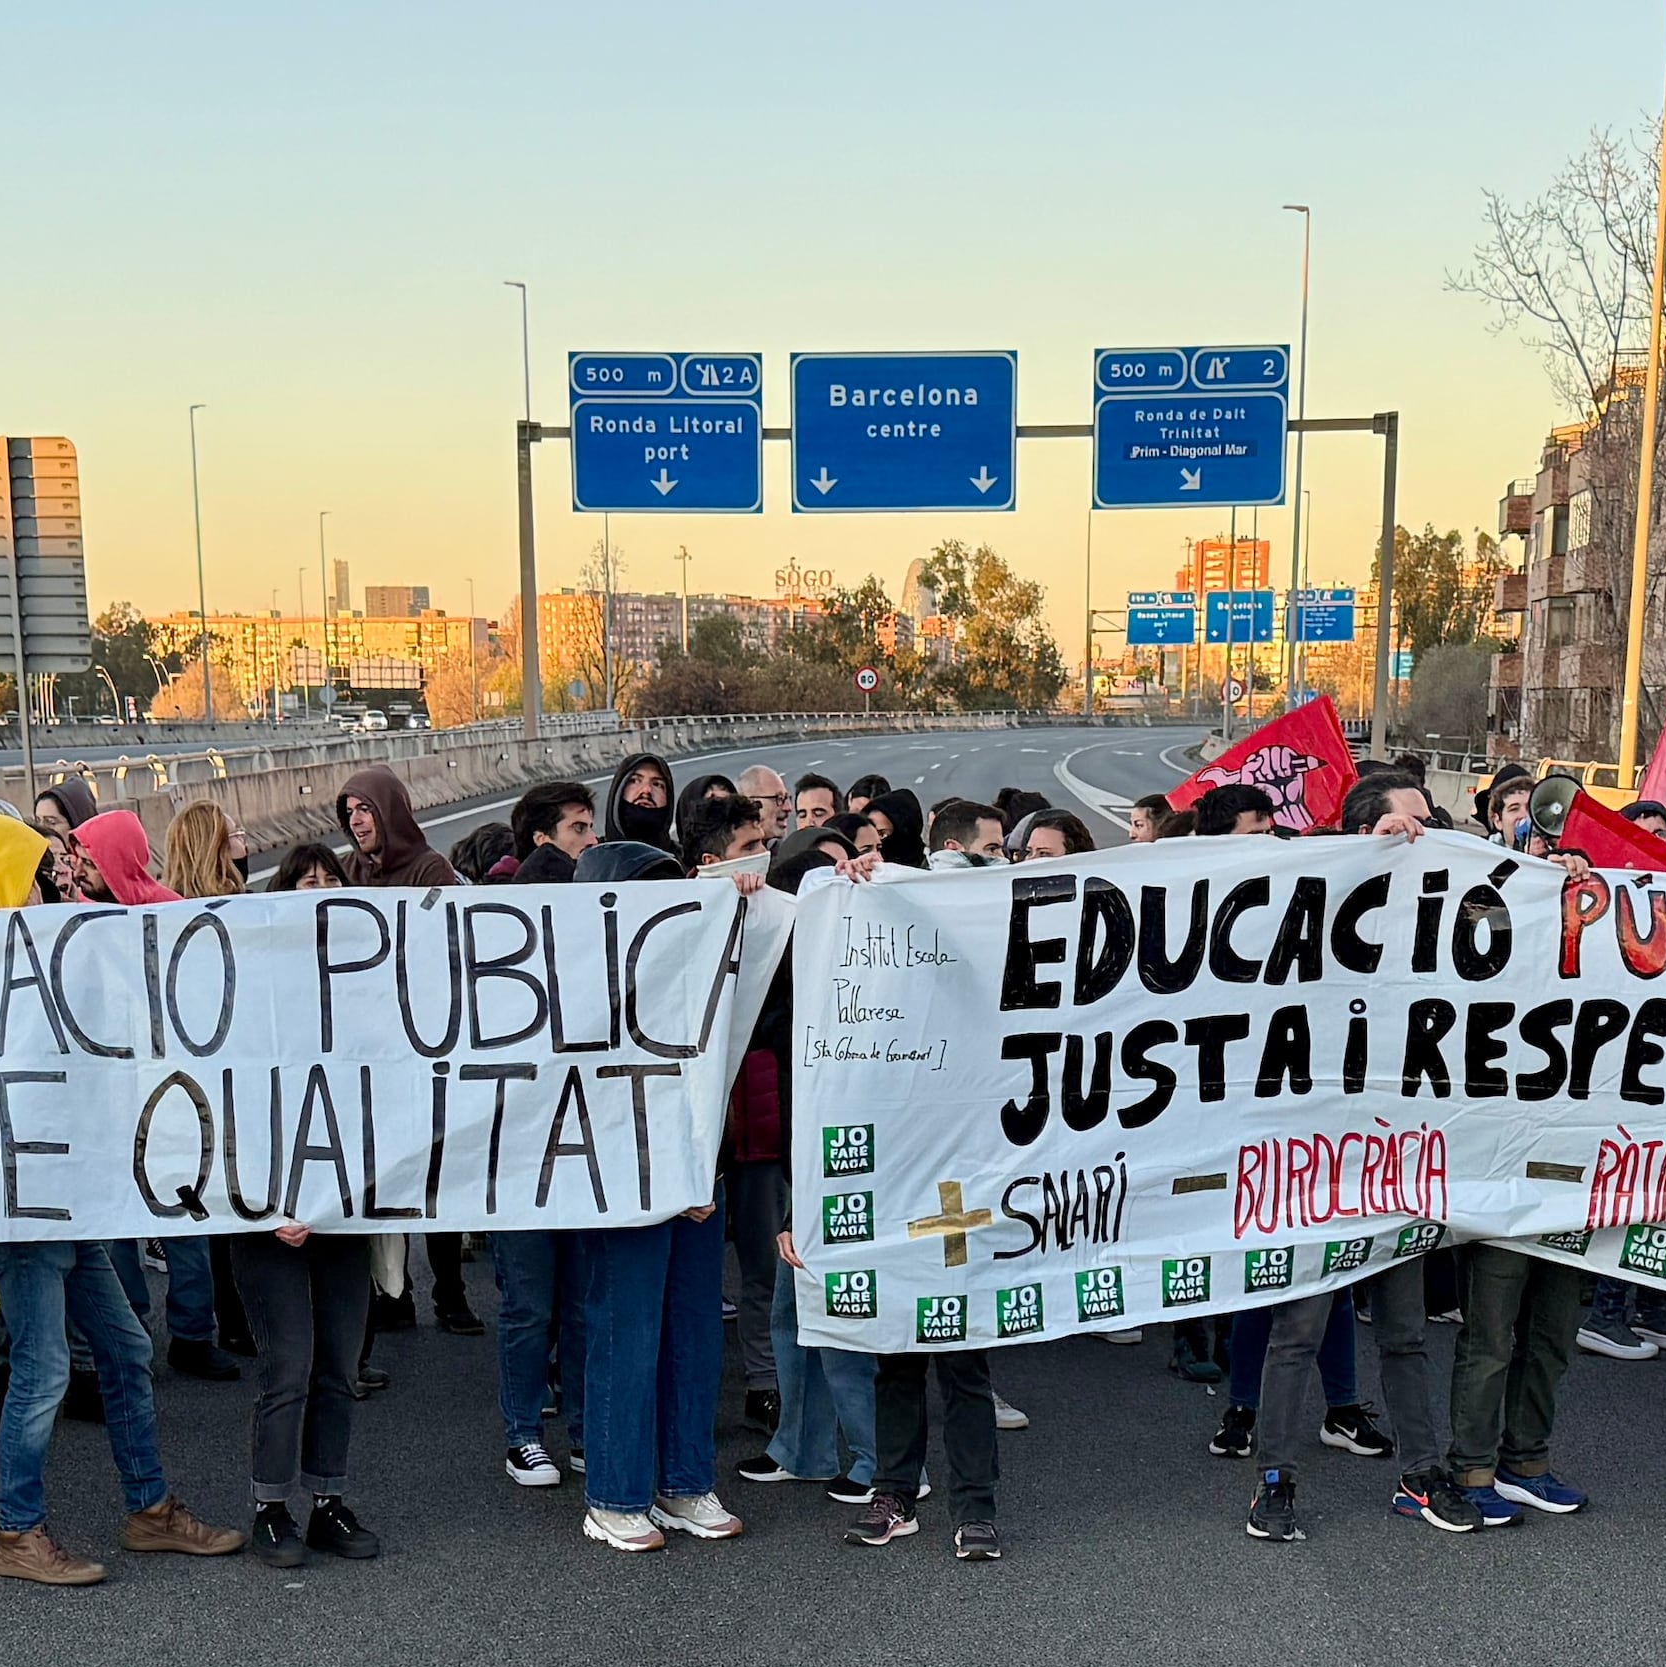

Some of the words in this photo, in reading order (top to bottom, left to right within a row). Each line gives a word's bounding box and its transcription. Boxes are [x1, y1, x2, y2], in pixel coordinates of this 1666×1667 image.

[587, 368, 624, 383] 500
[647, 371, 662, 383] m
[1111, 363, 1146, 378] 500
[1158, 365, 1173, 377] m
[1263, 359, 1275, 376] 2
[829, 384, 979, 407] Barcelona
[1135, 409, 1184, 422] Ronda
[1189, 408, 1207, 421] de
[1213, 408, 1247, 421] Dalt
[590, 416, 657, 434] Ronda
[669, 416, 744, 434] Litoral
[866, 421, 942, 438] centre
[1160, 426, 1221, 440] Trinitat
[644, 444, 690, 464] port
[1170, 445, 1222, 460] Diagonal
[1225, 444, 1248, 456] Mar
[775, 570, 833, 587] SOGO
[906, 924, 959, 968] Escola
[833, 978, 906, 1026] Pallaresa
[1000, 1004, 1313, 1147] JUSTA
[830, 1126, 868, 1147] JO
[830, 1156, 869, 1171] VAGA
[829, 1193, 867, 1214] JO
[830, 1224, 868, 1237] VAGA
[1404, 1224, 1439, 1243] JO
[1331, 1239, 1366, 1258] JO
[1252, 1249, 1288, 1268] JO
[1627, 1254, 1664, 1272] VAGA
[1169, 1259, 1205, 1279] JO
[832, 1272, 870, 1292] JO
[1082, 1268, 1116, 1291] JO
[1251, 1275, 1287, 1287] VAGA
[1003, 1286, 1037, 1309] JO
[1169, 1287, 1205, 1301] VAGA
[833, 1302, 871, 1313] VAGA
[924, 1297, 961, 1317] JO
[1084, 1301, 1119, 1315] VAGA
[924, 1326, 961, 1338] VAGA
[1003, 1317, 1038, 1332] VAGA
